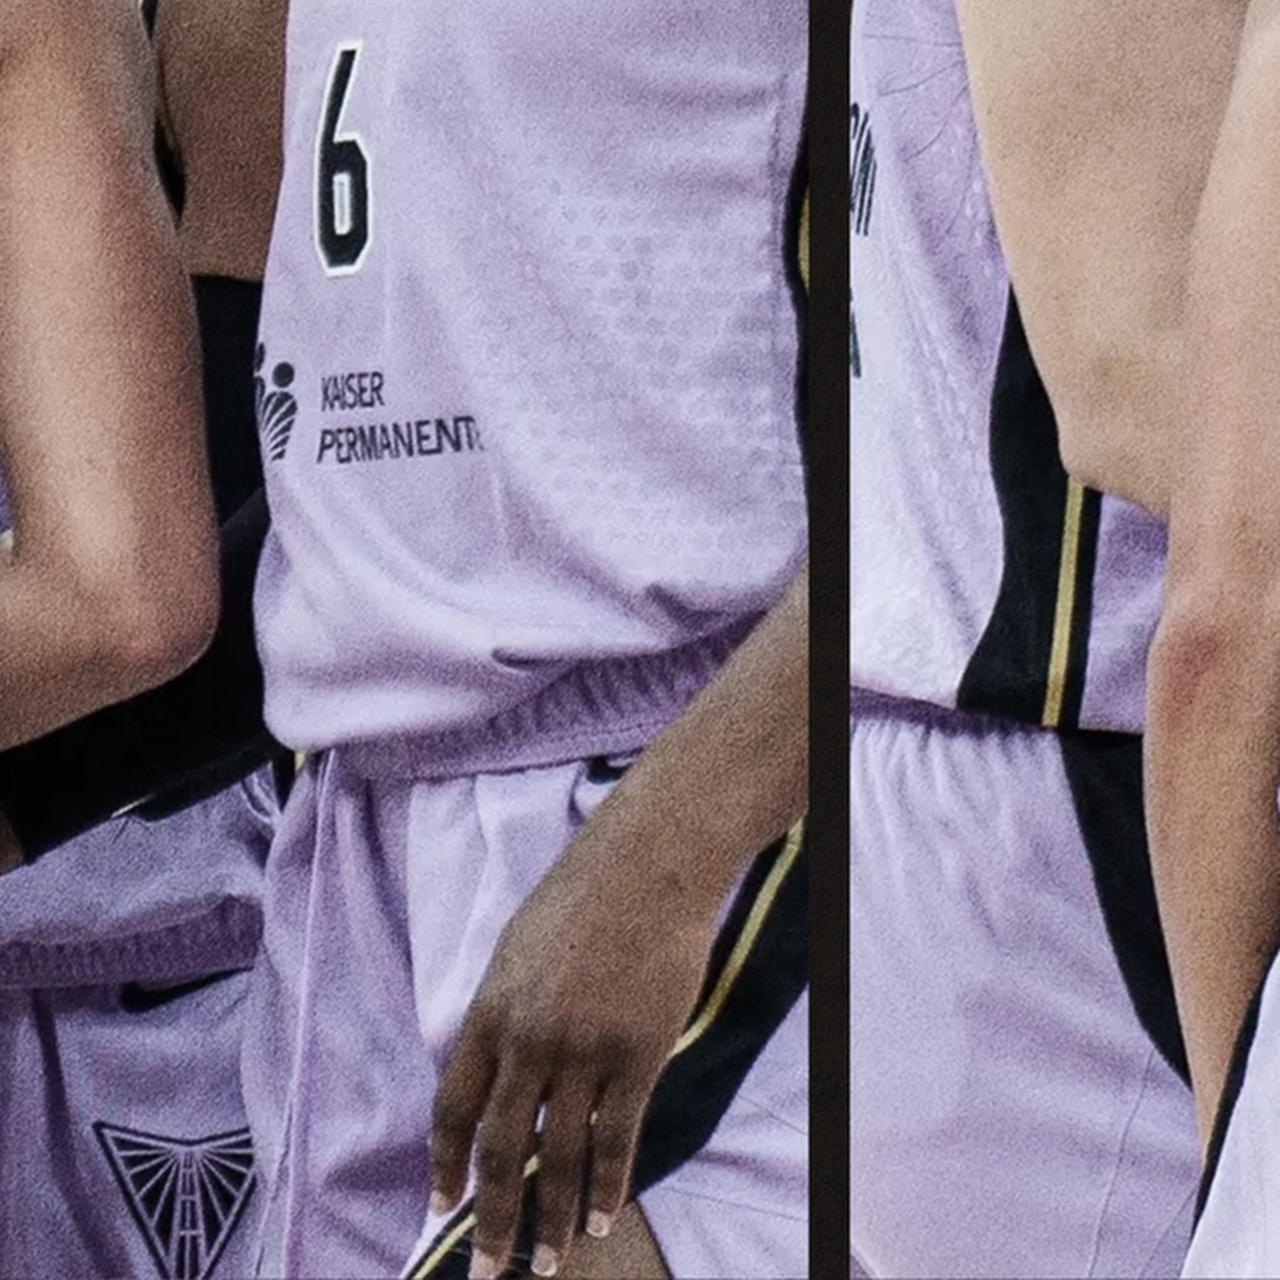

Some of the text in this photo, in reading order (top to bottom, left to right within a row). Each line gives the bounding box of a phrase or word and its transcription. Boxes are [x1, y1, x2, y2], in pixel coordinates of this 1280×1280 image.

[314, 39, 373, 277] 6
[320, 371, 385, 412] KAISER
[315, 415, 484, 464] PERMANENT
